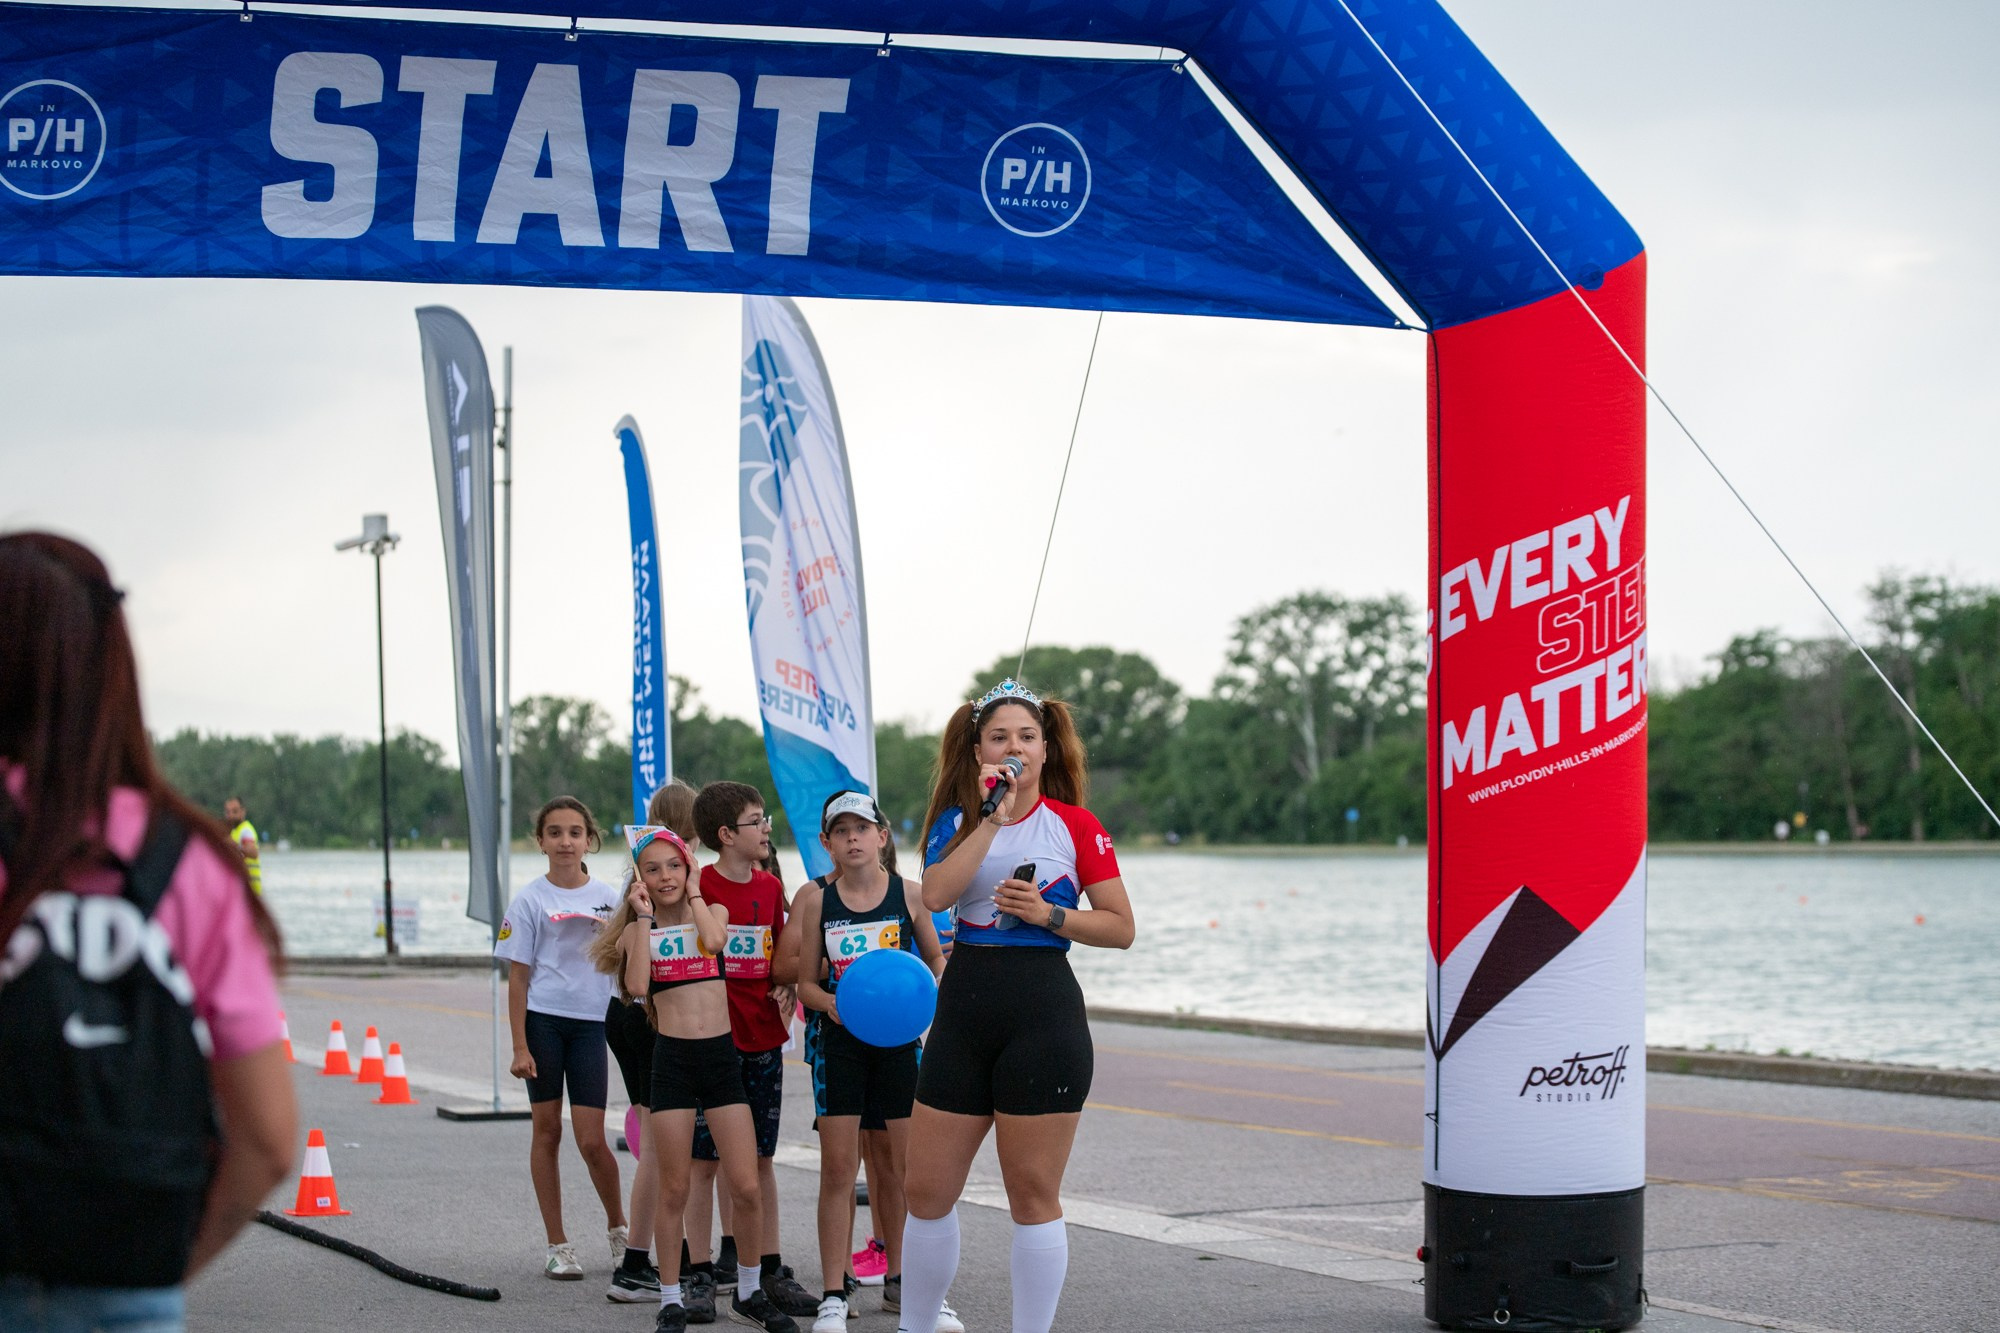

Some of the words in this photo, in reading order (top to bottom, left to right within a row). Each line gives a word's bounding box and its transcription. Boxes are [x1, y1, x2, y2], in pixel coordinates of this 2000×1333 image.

[8, 117, 85, 155] P/H
[261, 51, 850, 256] START
[1031, 146, 1046, 154] IN
[7, 160, 82, 169] MARKOVO
[1001, 157, 1072, 195] P/H
[1000, 197, 1069, 209] MARKOVO
[1440, 494, 1631, 642] EVERY
[658, 936, 684, 957] 61
[729, 935, 756, 955] 63
[839, 934, 868, 956] 62
[1536, 1092, 1591, 1102] STUDIO
